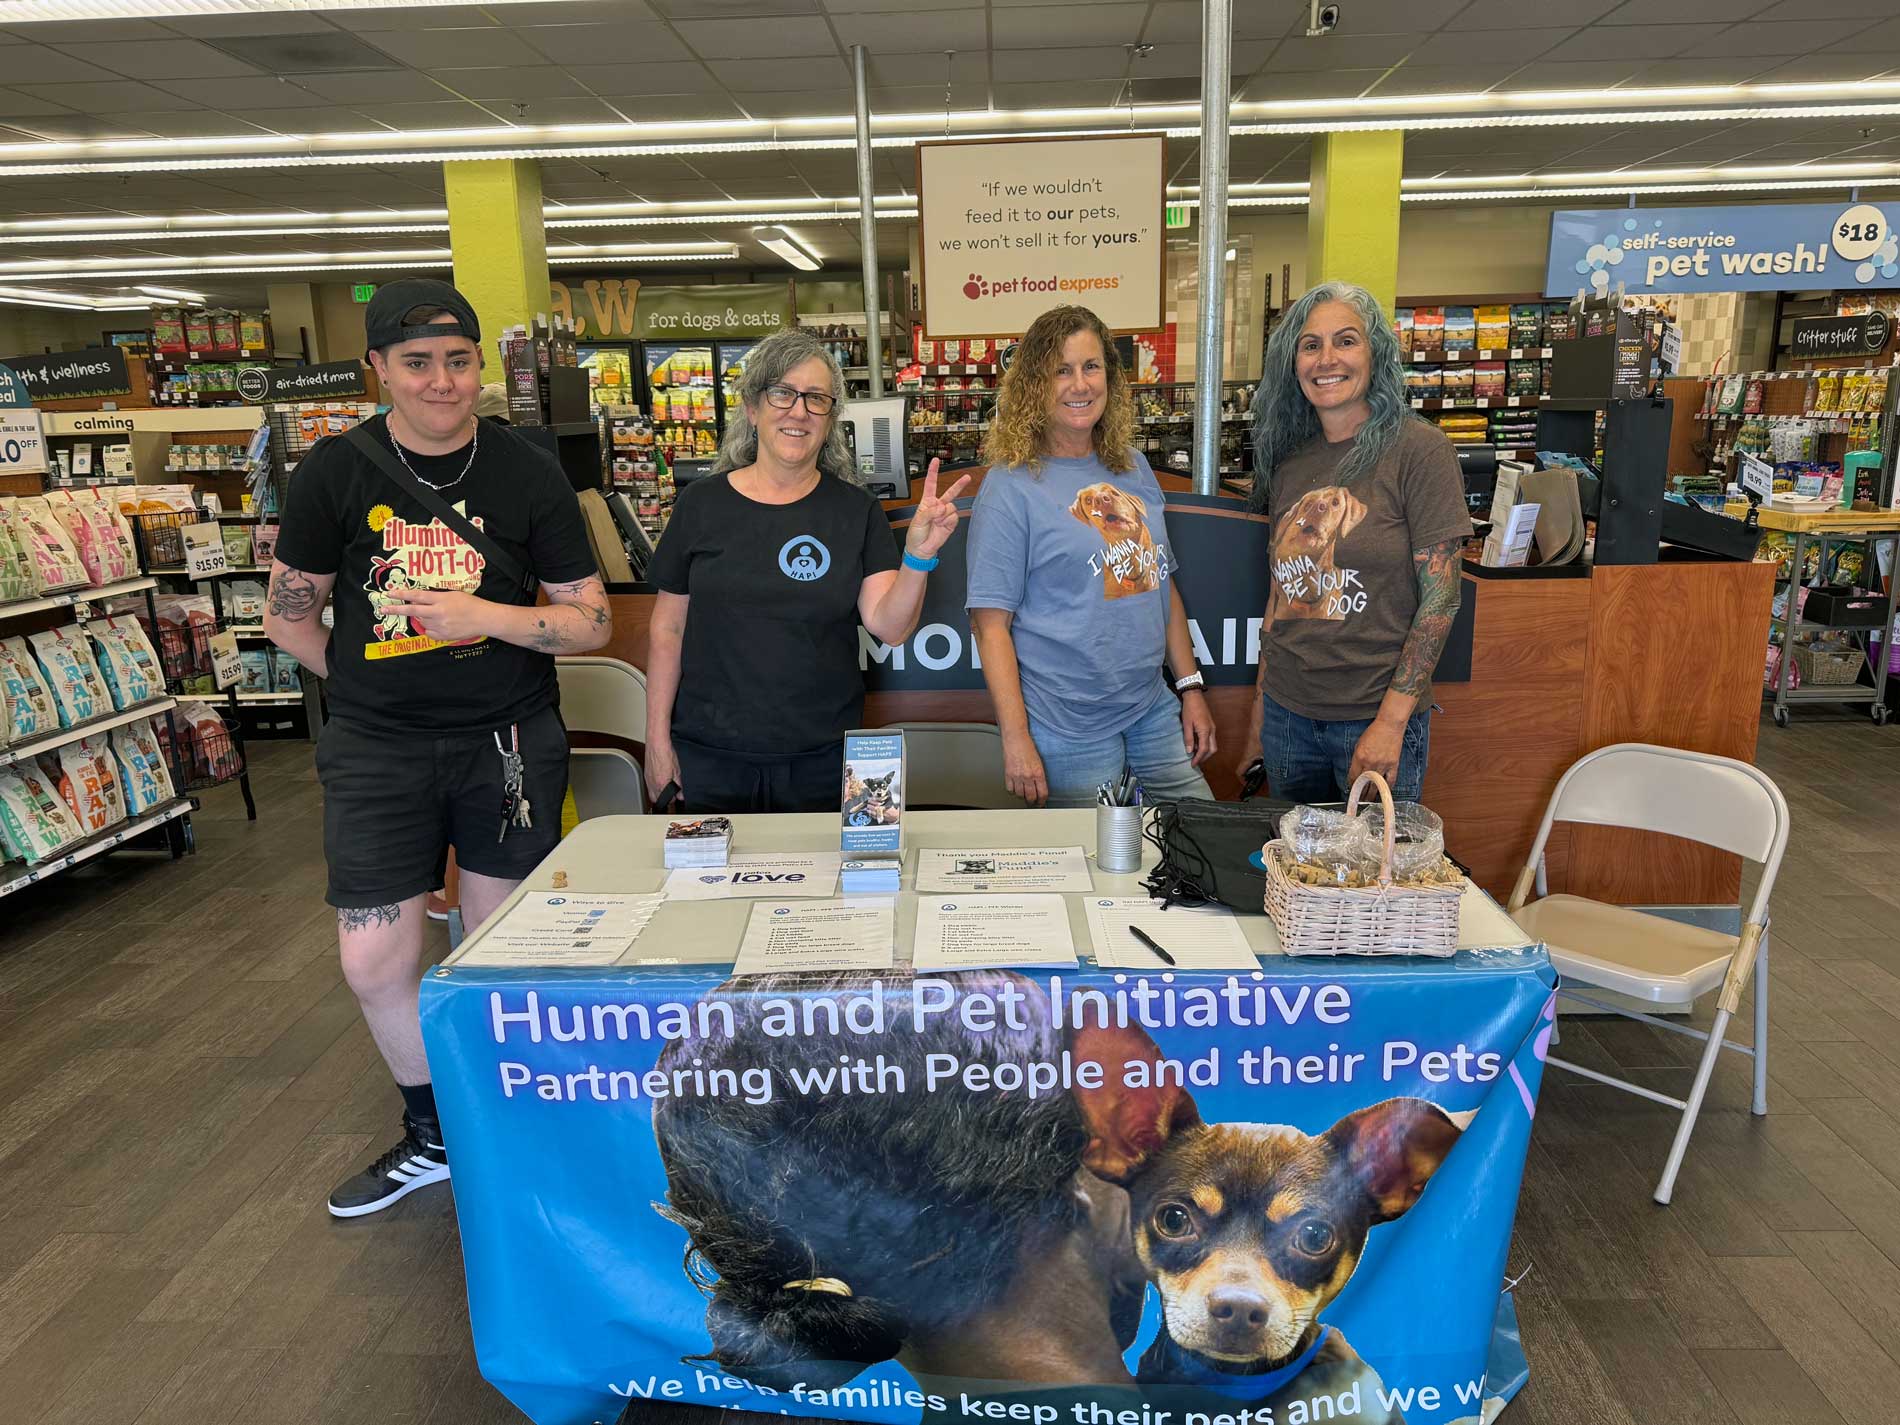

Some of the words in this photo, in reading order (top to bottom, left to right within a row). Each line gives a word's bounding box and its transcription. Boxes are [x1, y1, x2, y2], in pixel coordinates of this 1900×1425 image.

[1004, 184, 1028, 196] we
[965, 208, 1002, 224] feed
[1008, 208, 1020, 222] it
[1024, 208, 1042, 222] to
[1046, 207, 1074, 220] our
[1079, 204, 1120, 223] pets,
[939, 238, 962, 250] we
[1016, 232, 1042, 248] sell
[1048, 232, 1058, 246] it
[1064, 231, 1087, 246] for
[1622, 232, 1735, 250] self-service
[1838, 223, 1878, 242] $18
[1646, 249, 1710, 286] pet
[1722, 244, 1828, 274] wash!
[1060, 276, 1119, 294] express
[648, 312, 678, 328] for
[682, 310, 722, 332] dogs
[725, 309, 740, 325] &
[742, 309, 780, 326] cats
[1798, 330, 1828, 348] critter
[1830, 328, 1858, 348] stuff
[40, 366, 50, 384] &
[52, 362, 111, 380] wellness
[276, 373, 323, 390] air-dried
[330, 371, 356, 383] more
[74, 416, 134, 431] calming
[21, 440, 38, 448] OFF
[196, 556, 224, 572] $15.99
[1087, 552, 1101, 576] I
[1101, 538, 1142, 567] WANNA
[1112, 560, 1133, 584] BE
[1135, 544, 1166, 570] YOUR
[790, 570, 816, 580] HAPI
[1150, 563, 1168, 586] DOG
[1282, 576, 1307, 603] BE
[1310, 568, 1364, 596] YOUR
[1326, 591, 1368, 616] DOG
[378, 645, 392, 656] THE
[394, 637, 432, 653] ORIGINAL
[222, 662, 241, 681] $15.99
[731, 872, 806, 883] love
[489, 990, 735, 1044] Human
[761, 980, 885, 1040] and
[913, 978, 1028, 1033] Pet
[1050, 972, 1351, 1030] Initiative
[500, 1058, 773, 1105] Partnering
[790, 1054, 906, 1096] with
[926, 1051, 1104, 1100] People
[1124, 1048, 1219, 1090] and
[1237, 1044, 1365, 1084] their
[1382, 1041, 1501, 1084] Pets
[609, 1376, 684, 1398] We
[695, 1370, 778, 1398] help
[788, 1379, 946, 1412] families
[960, 1393, 1058, 1425] keep
[1070, 1398, 1171, 1425] their
[1288, 1381, 1361, 1424] and
[1376, 1383, 1440, 1412] we
